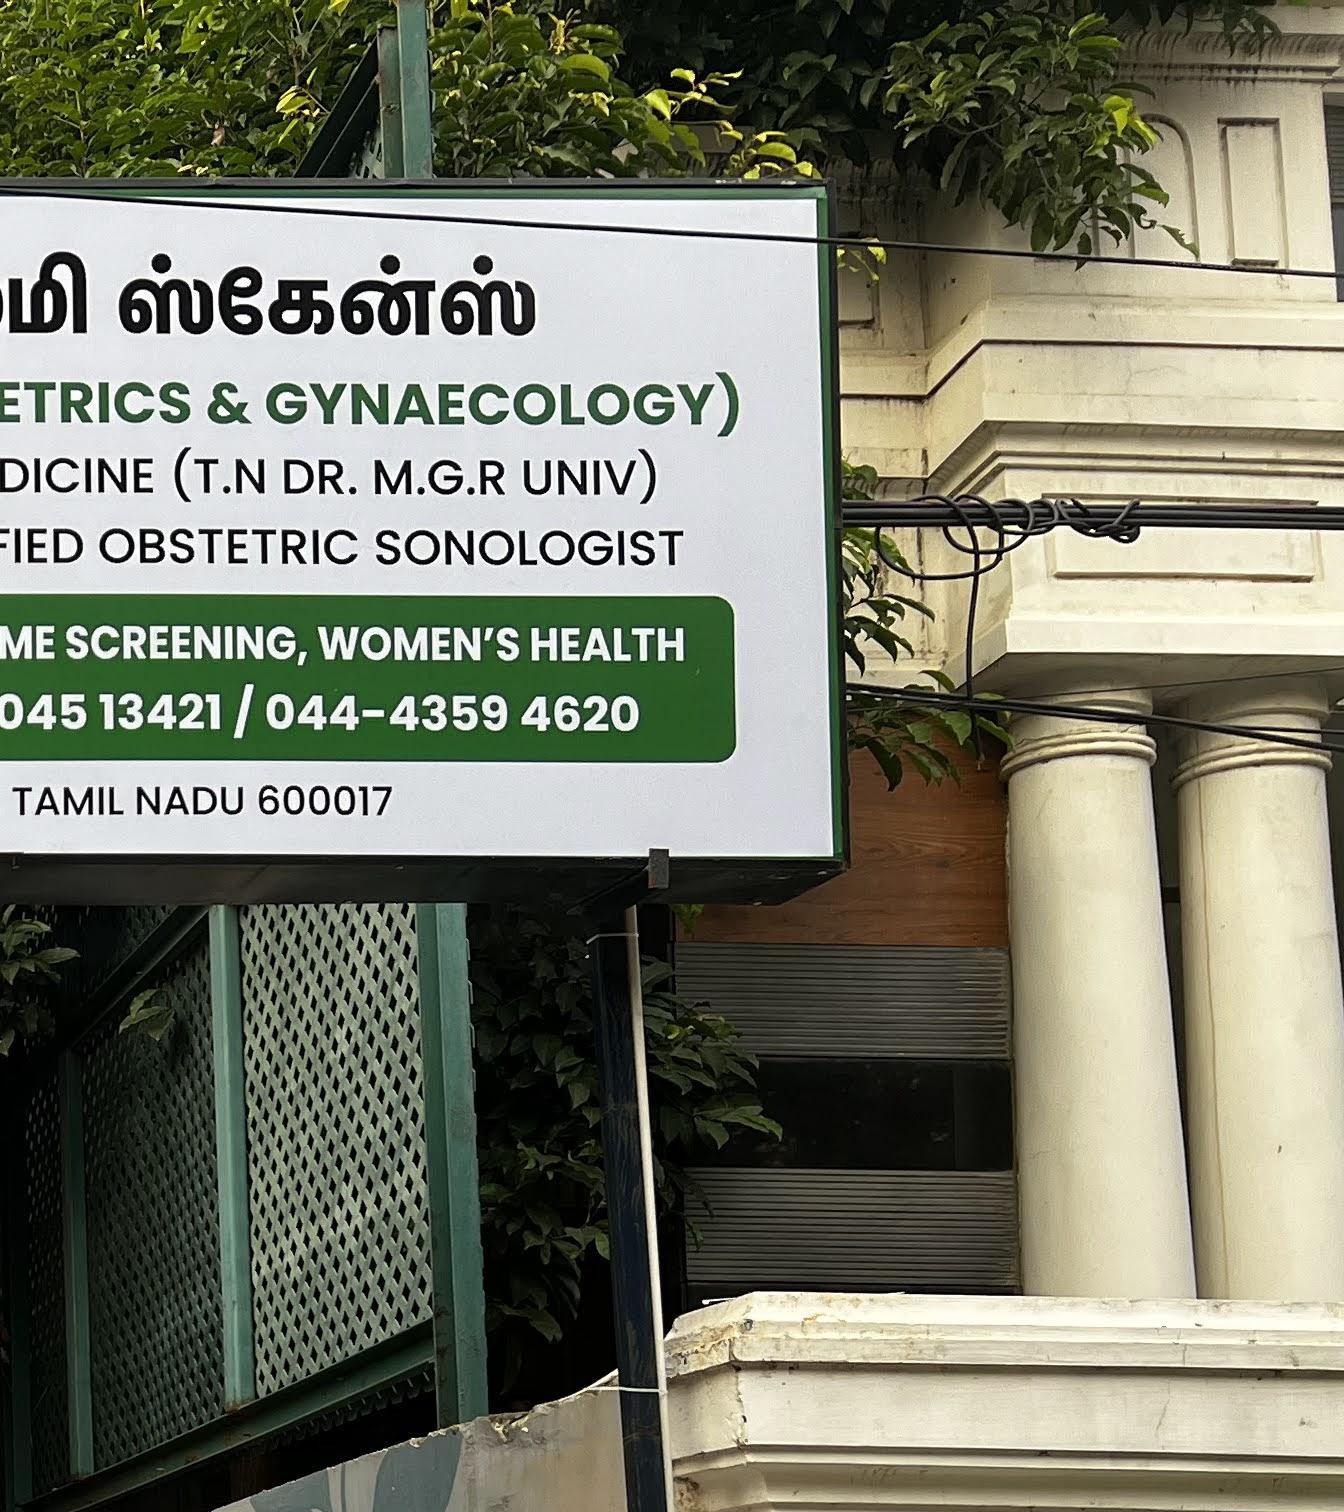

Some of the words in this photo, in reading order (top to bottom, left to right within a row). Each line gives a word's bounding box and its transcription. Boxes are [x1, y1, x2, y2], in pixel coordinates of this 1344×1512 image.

[119, 254, 535, 337] ஸ்கேன்ஸ்
[208, 382, 252, 425] &
[266, 371, 739, 436] GYNAECOLOGY)
[175, 447, 265, 503] (T.N
[284, 459, 356, 495] DR.
[375, 459, 505, 495] M.G.R
[524, 448, 656, 504] UNIV)
[99, 528, 357, 564] OBSTETRIC
[376, 530, 683, 566] SONOLOGIST
[66, 625, 307, 665] SCREENING,
[531, 627, 683, 661] HEALTH
[100, 694, 220, 730] 13421
[234, 684, 254, 739] /
[267, 694, 507, 732] 044-4359
[522, 696, 638, 732] 4620
[12, 787, 123, 816] TAMIL
[137, 787, 243, 816] NADU
[259, 785, 392, 816] 600017
